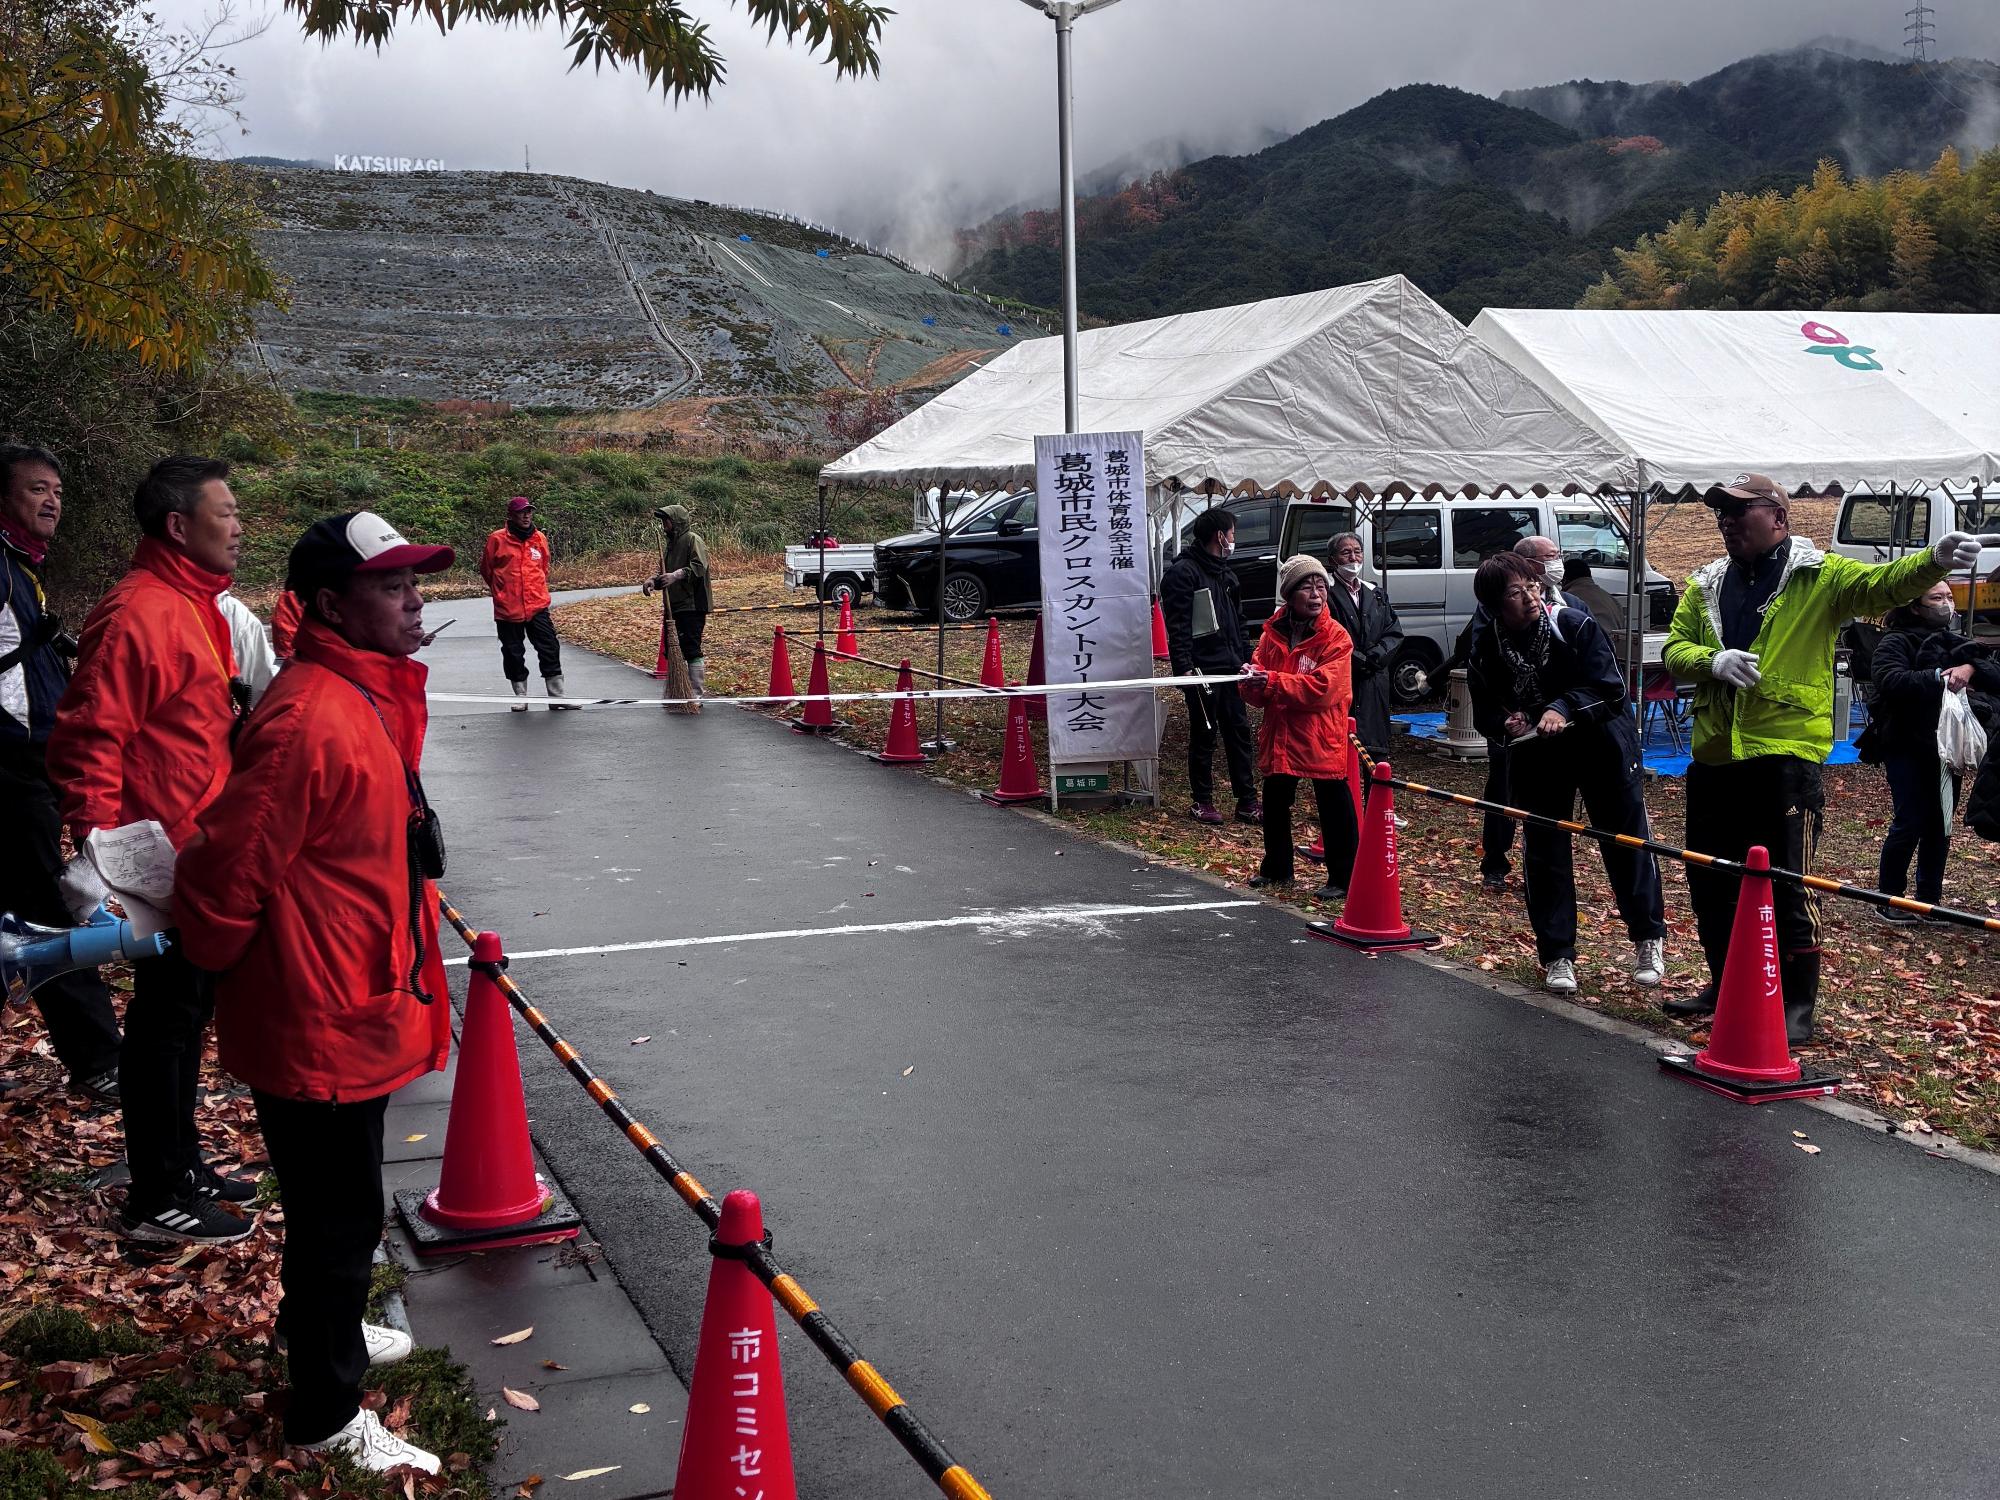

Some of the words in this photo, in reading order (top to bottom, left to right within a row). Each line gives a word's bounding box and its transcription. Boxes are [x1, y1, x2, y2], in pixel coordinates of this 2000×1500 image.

[334, 154, 445, 171] KATSURAGI
[1104, 450, 1135, 570] 葛城市体育協会主催
[1054, 452, 1107, 732] 葛城市民クロスカントリー大会
[1014, 715, 1026, 762] 市コミセン
[1065, 778, 1097, 788] 葛城市
[1383, 808, 1395, 878] 市コミセン
[1758, 904, 1778, 997] 市コミセン
